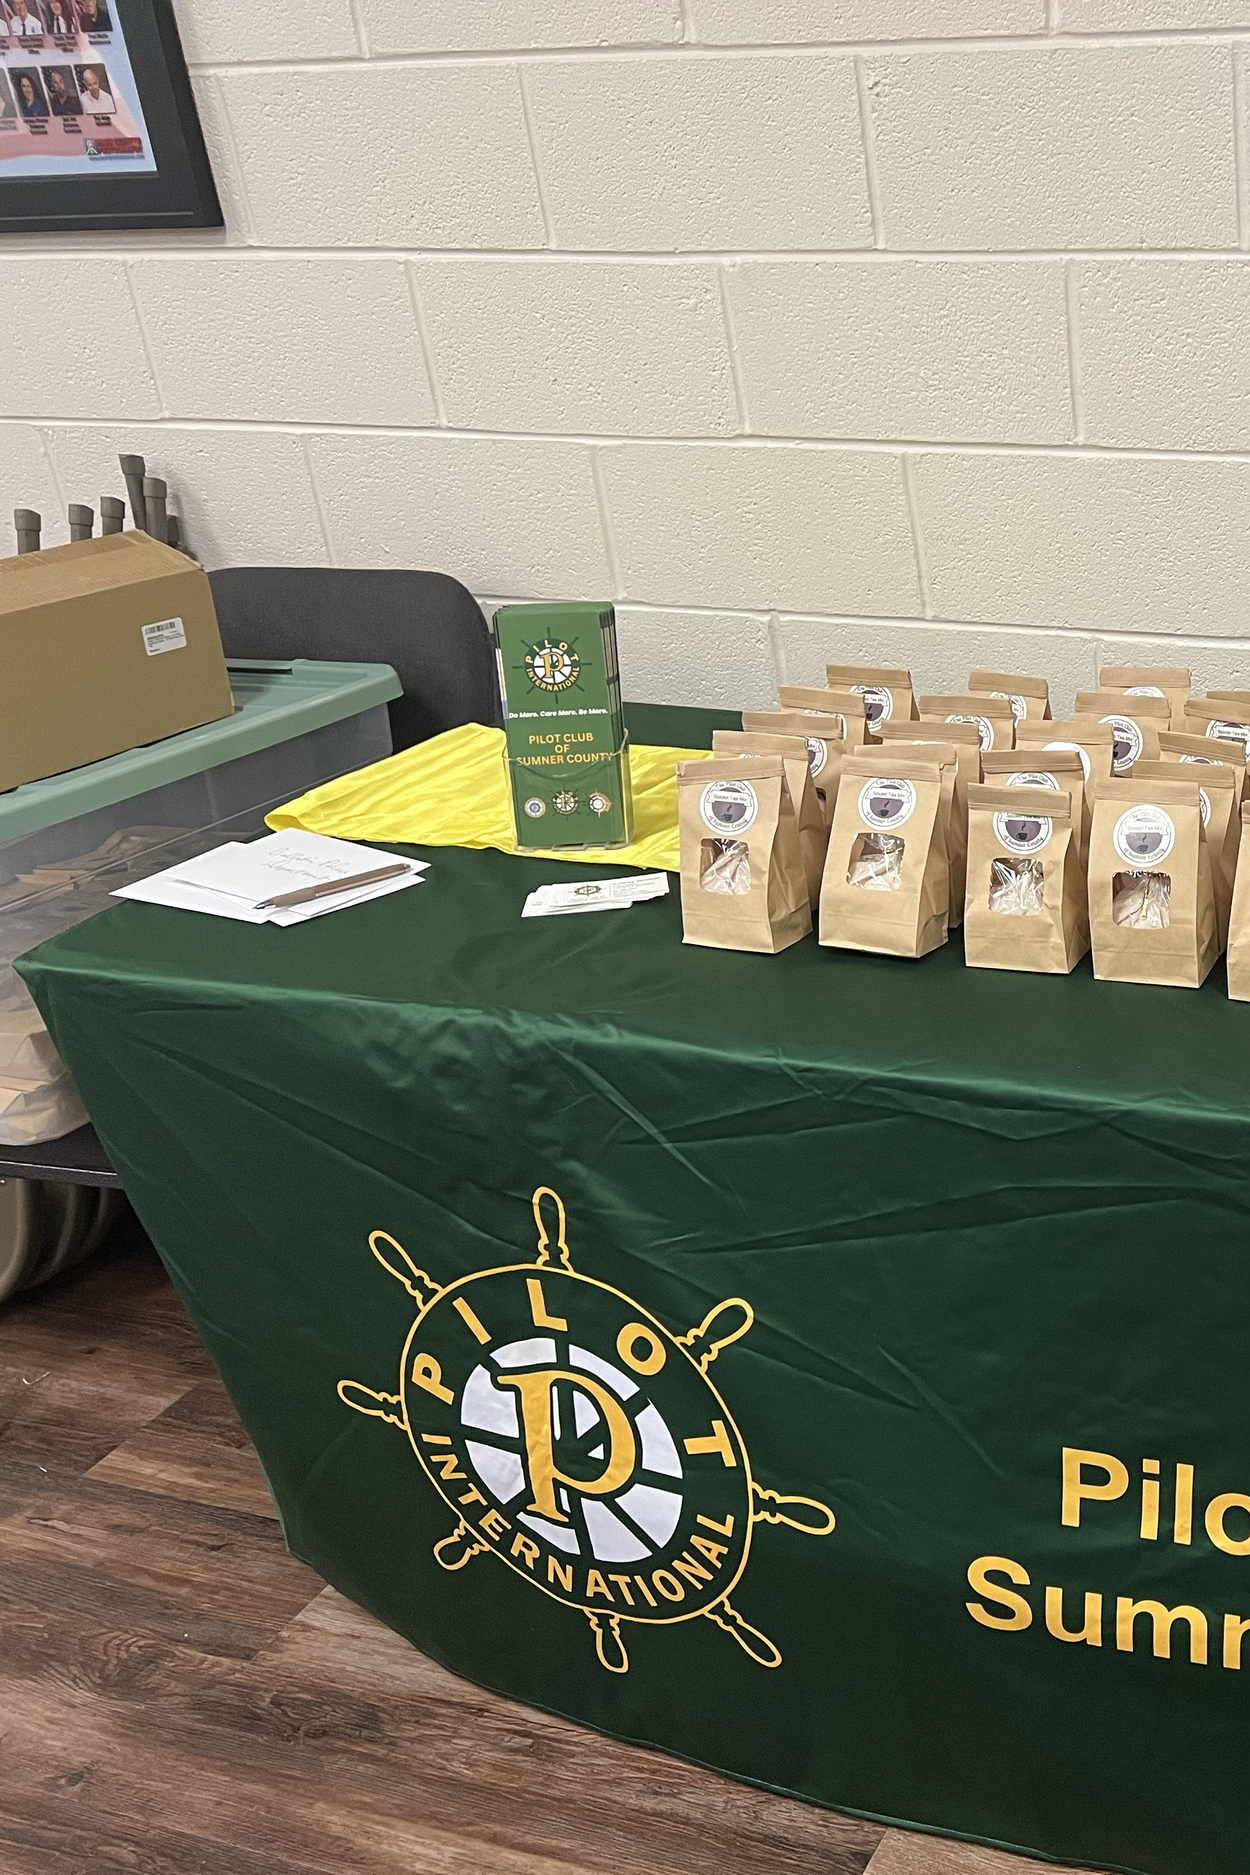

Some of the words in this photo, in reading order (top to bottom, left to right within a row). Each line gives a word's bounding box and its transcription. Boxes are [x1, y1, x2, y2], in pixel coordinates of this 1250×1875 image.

[525, 639, 579, 664] PILOT
[526, 666, 580, 692] INTERNATIONAL
[528, 734, 561, 744] PILOT
[563, 732, 594, 742] CLUB
[555, 744, 570, 753] OF
[516, 755, 564, 766] SUMNER
[566, 752, 613, 763] COUNTY
[412, 1278, 737, 1469] PILOT
[422, 1433, 735, 1607] INTERNATIONAL
